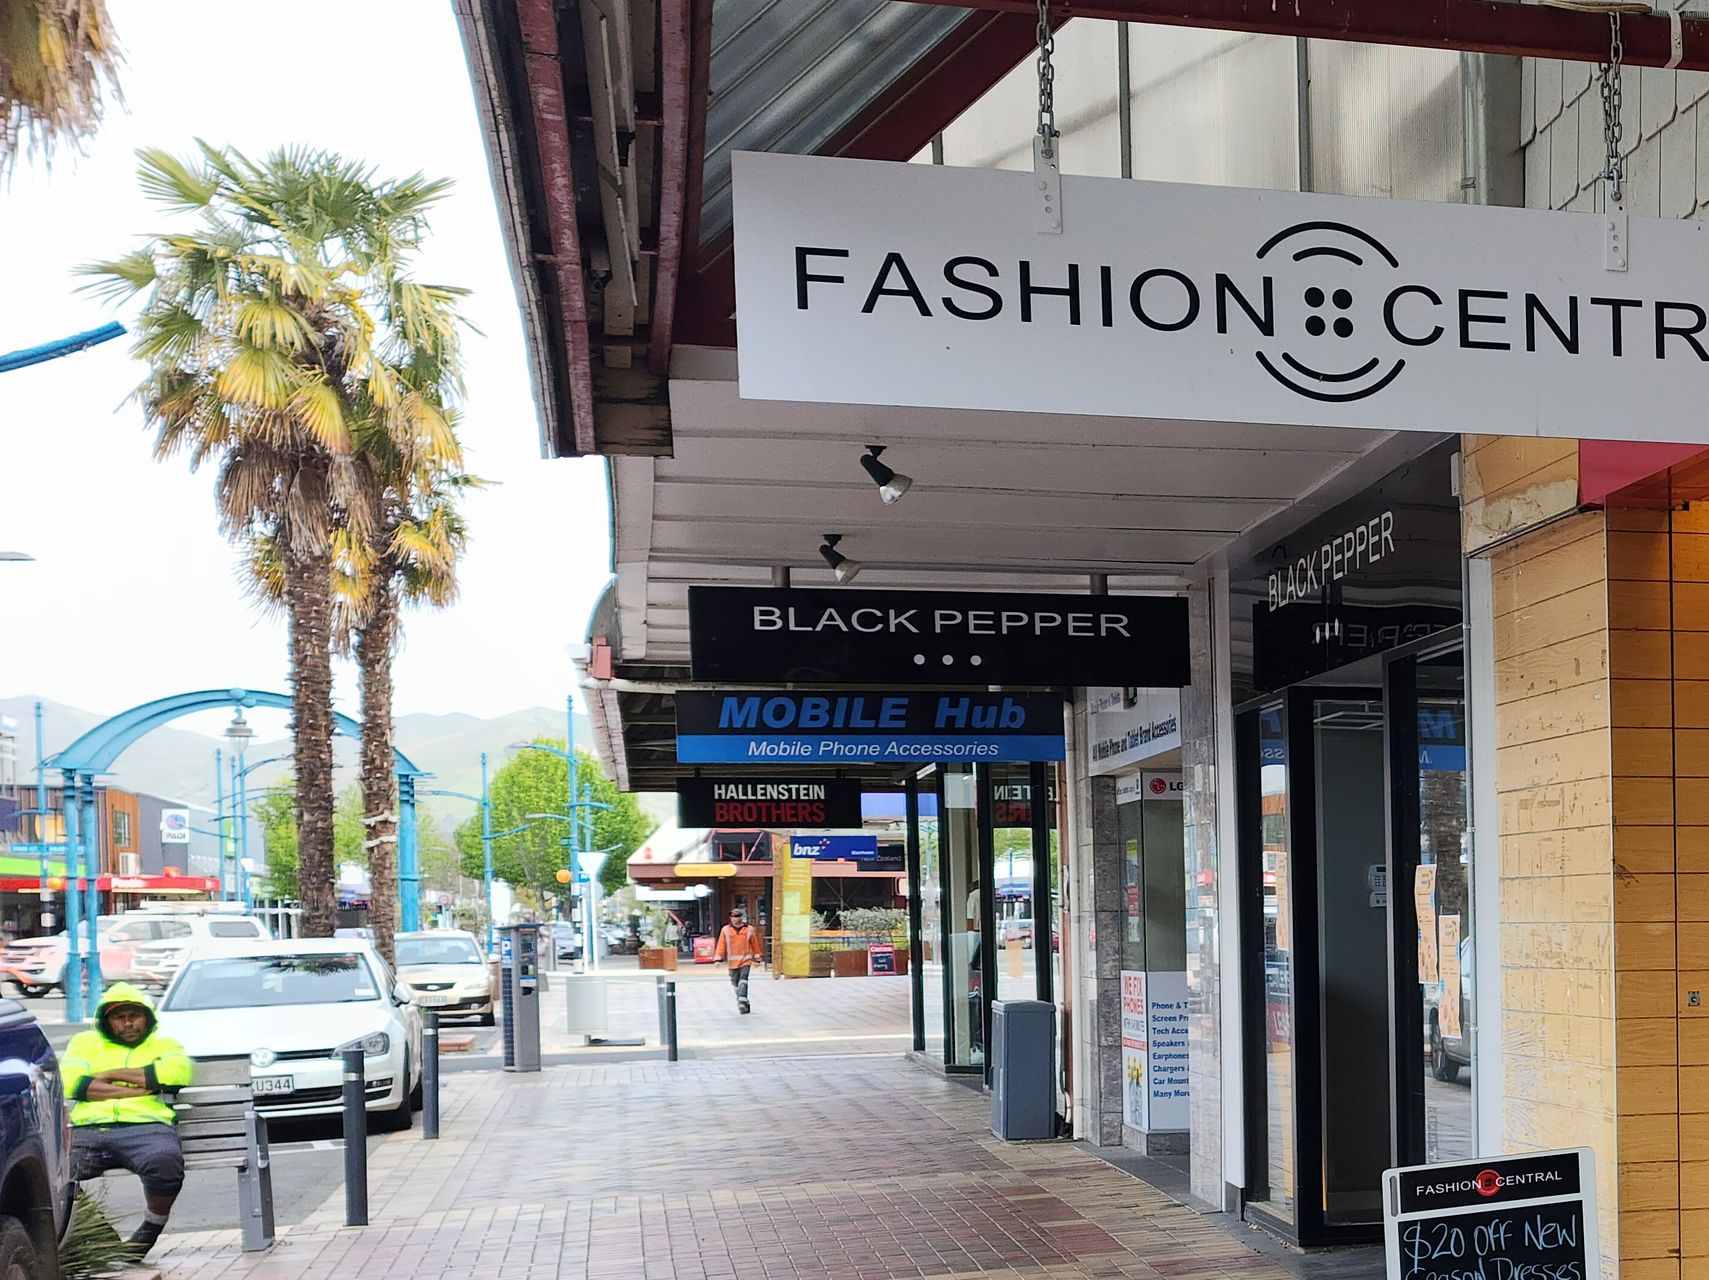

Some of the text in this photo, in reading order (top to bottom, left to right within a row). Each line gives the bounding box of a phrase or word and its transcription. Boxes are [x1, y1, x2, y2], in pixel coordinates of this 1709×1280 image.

[794, 245, 1274, 338] FASHION
[1268, 510, 1396, 612] BLACK PEPPER
[753, 606, 1132, 638] BLACK PEPPER
[718, 696, 1026, 729] MOBILE Hub
[748, 740, 999, 757] Mobile Phone Accessories
[713, 783, 826, 800] HALLENSTEIN
[714, 802, 827, 823] BROTHERS
[793, 843, 820, 856] bnz
[1151, 1001, 1174, 1010] Phone
[1151, 1014, 1177, 1022] Screen
[1152, 1027, 1170, 1035] Tech
[1152, 1039, 1186, 1049] Speakers
[1152, 1065, 1185, 1074] Chargers
[1153, 1077, 1165, 1085] Car
[1153, 1090, 1172, 1099] Many
[1415, 1170, 1563, 1197] FASHION CENTRAL
[1403, 1220, 1466, 1274] $20
